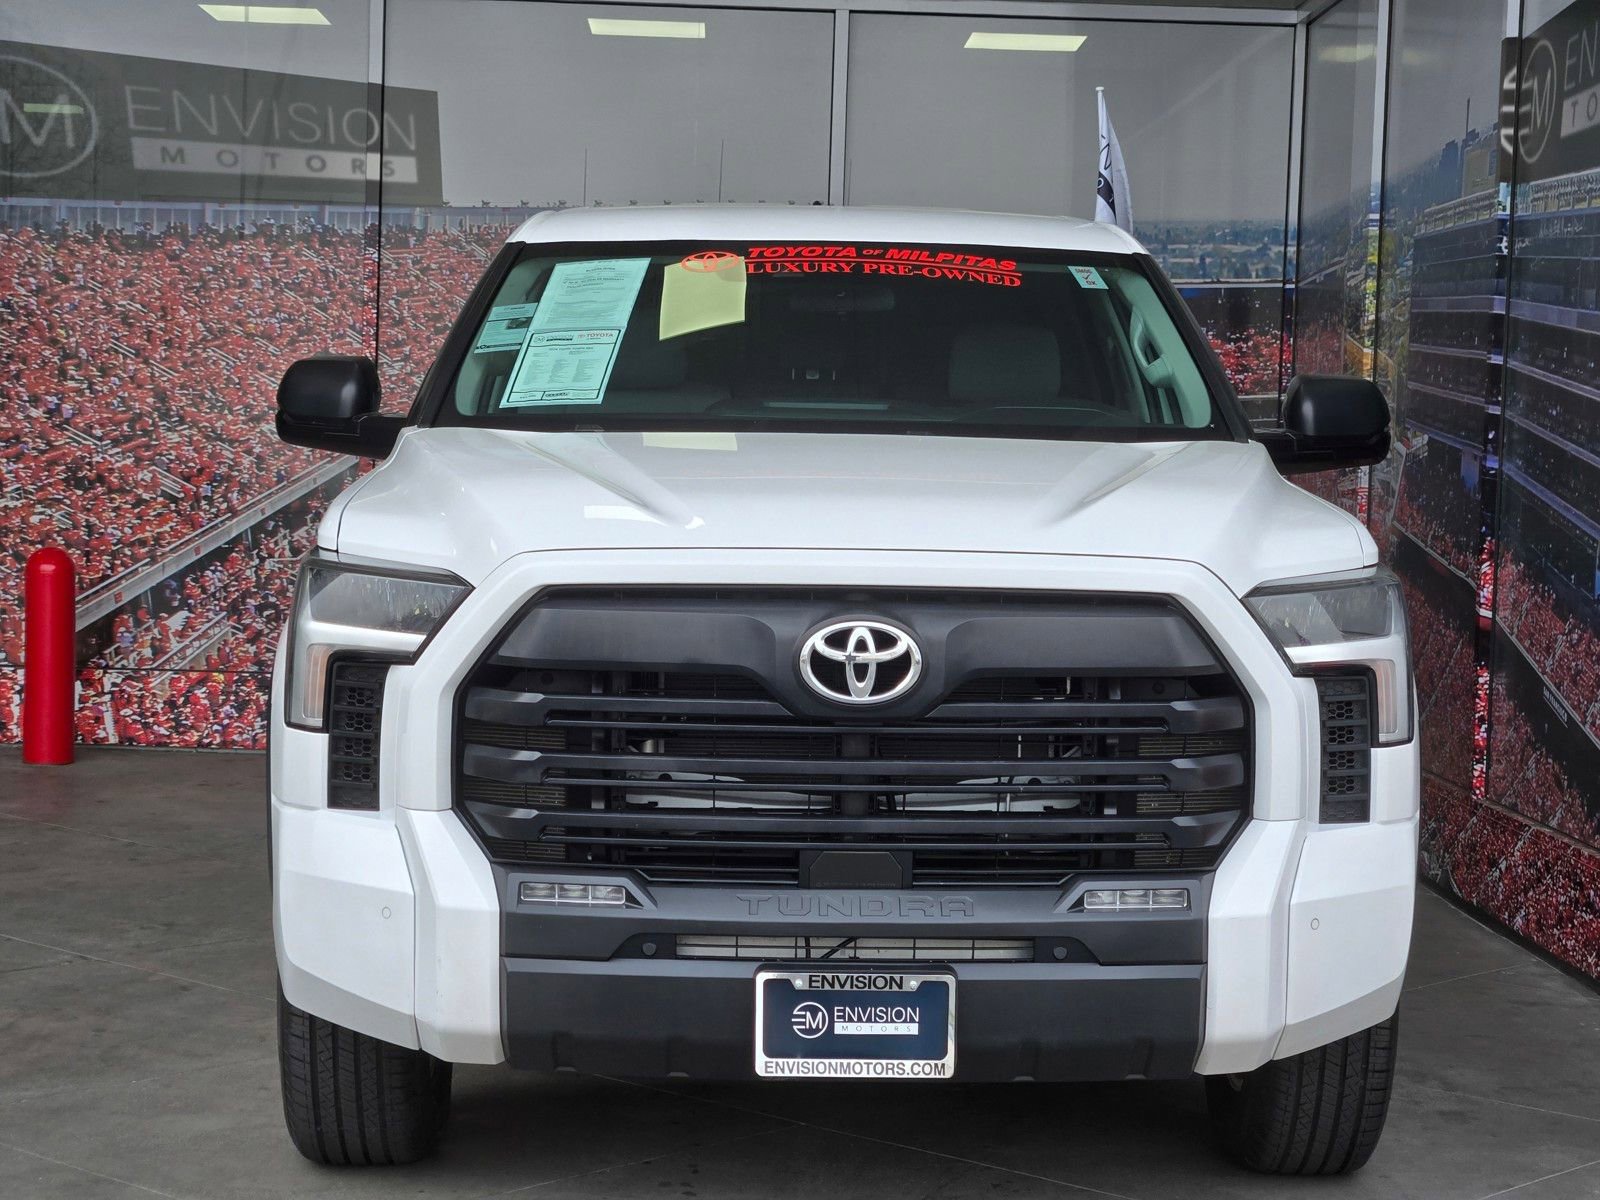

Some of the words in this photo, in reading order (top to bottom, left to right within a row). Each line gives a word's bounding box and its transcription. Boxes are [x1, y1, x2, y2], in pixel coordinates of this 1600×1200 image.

[125, 85, 417, 151] ENVISION
[160, 145, 396, 177] MOTORS
[748, 246, 857, 258] TOYOTA
[862, 248, 884, 256] OF
[885, 248, 1017, 271] MILPITAS
[747, 262, 857, 274] LUXURY
[863, 263, 1022, 287] PRE-OWNED
[736, 893, 975, 918] TUNDRA
[808, 974, 904, 990] ENVISION
[834, 1006, 920, 1023] ENVISION
[841, 1025, 912, 1033] MOTORS
[764, 1060, 946, 1077] ENVISIONMOTORS.COM
